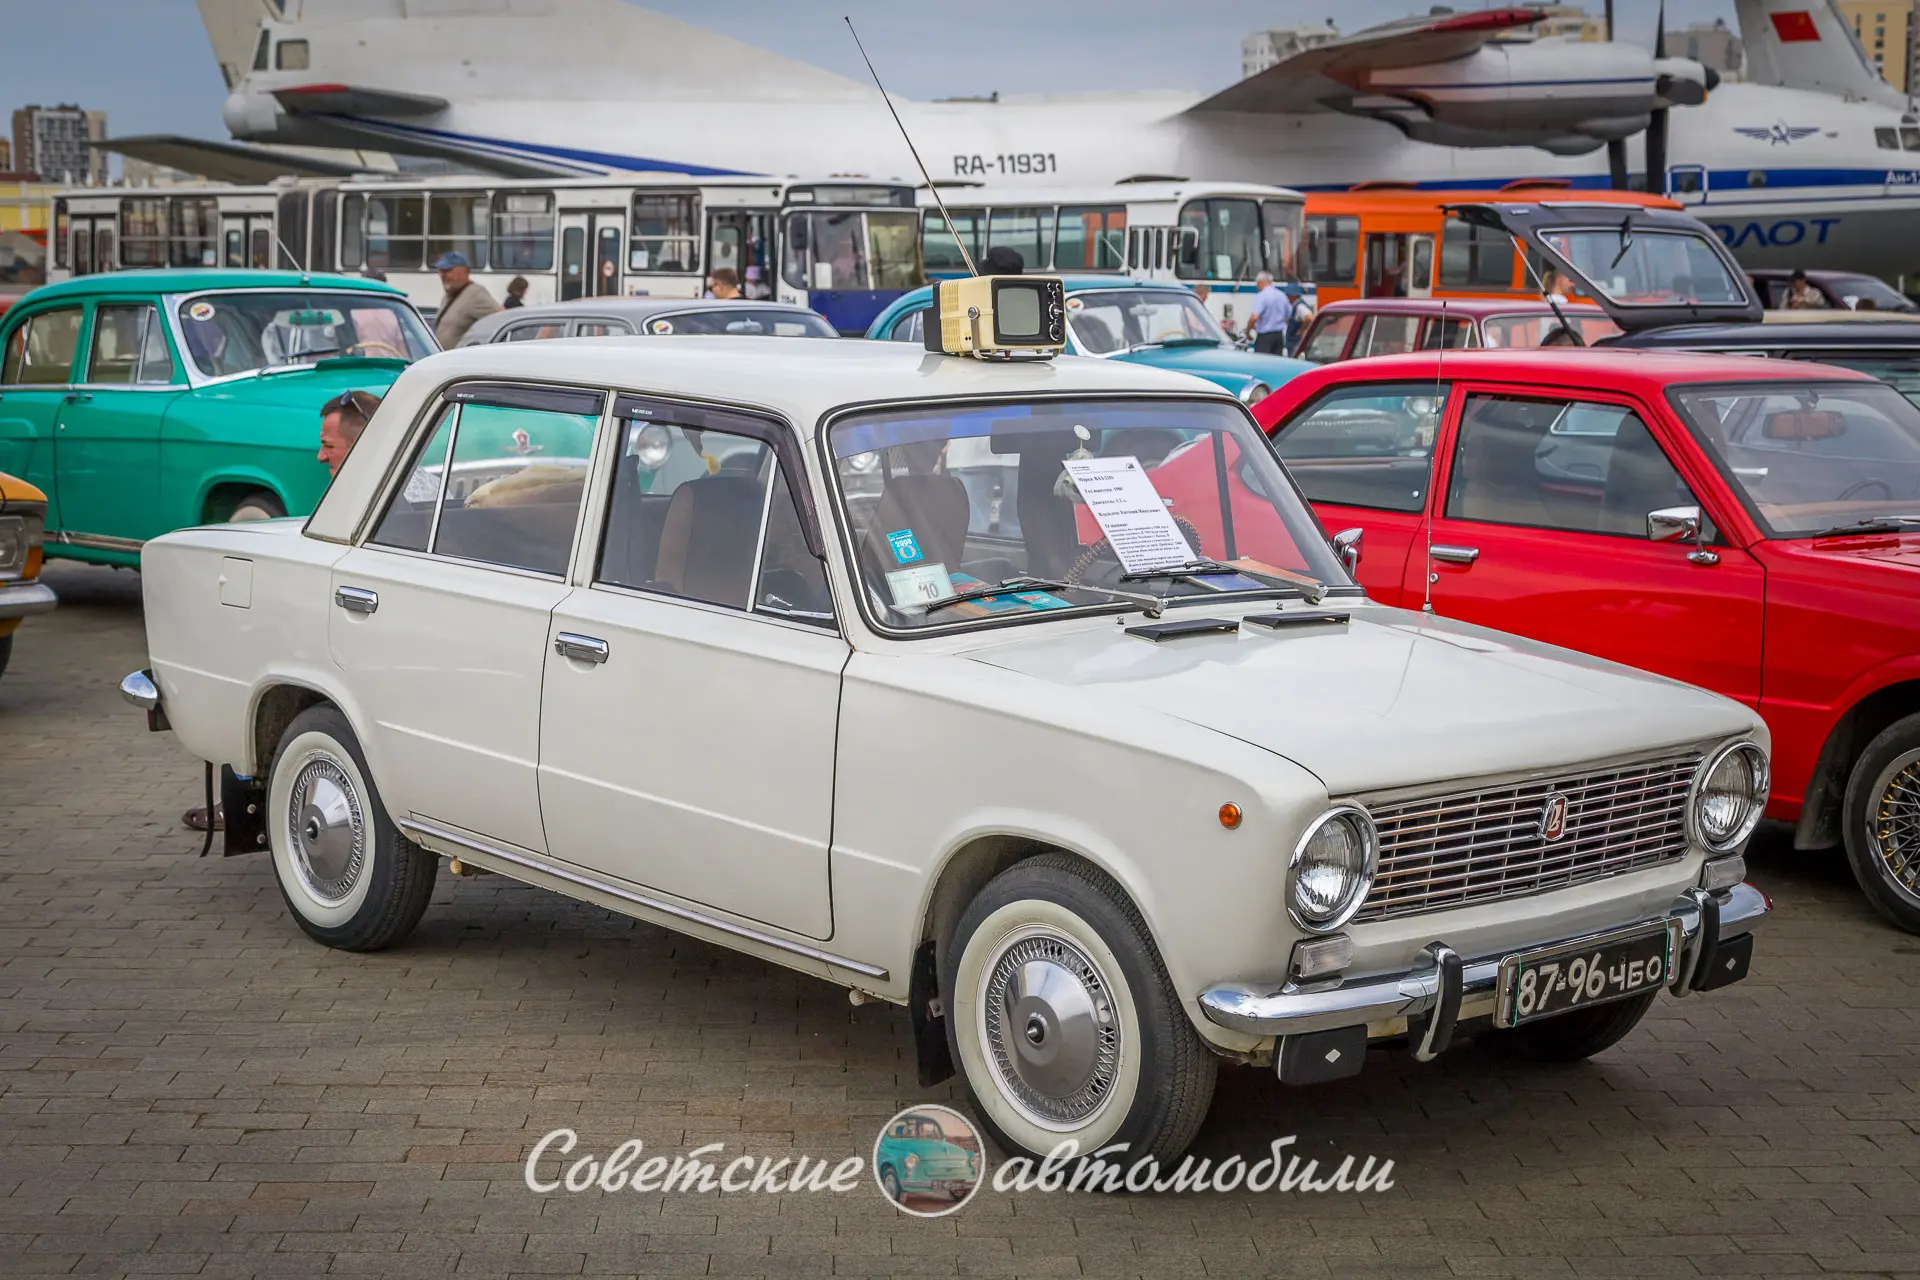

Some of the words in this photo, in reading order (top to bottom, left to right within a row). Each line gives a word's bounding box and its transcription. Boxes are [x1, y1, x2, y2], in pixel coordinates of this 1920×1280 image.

[954, 153, 1056, 175] RA-11931
[1885, 169, 1920, 186] Ан-1
[1609, 955, 1662, 991] ЧБО
